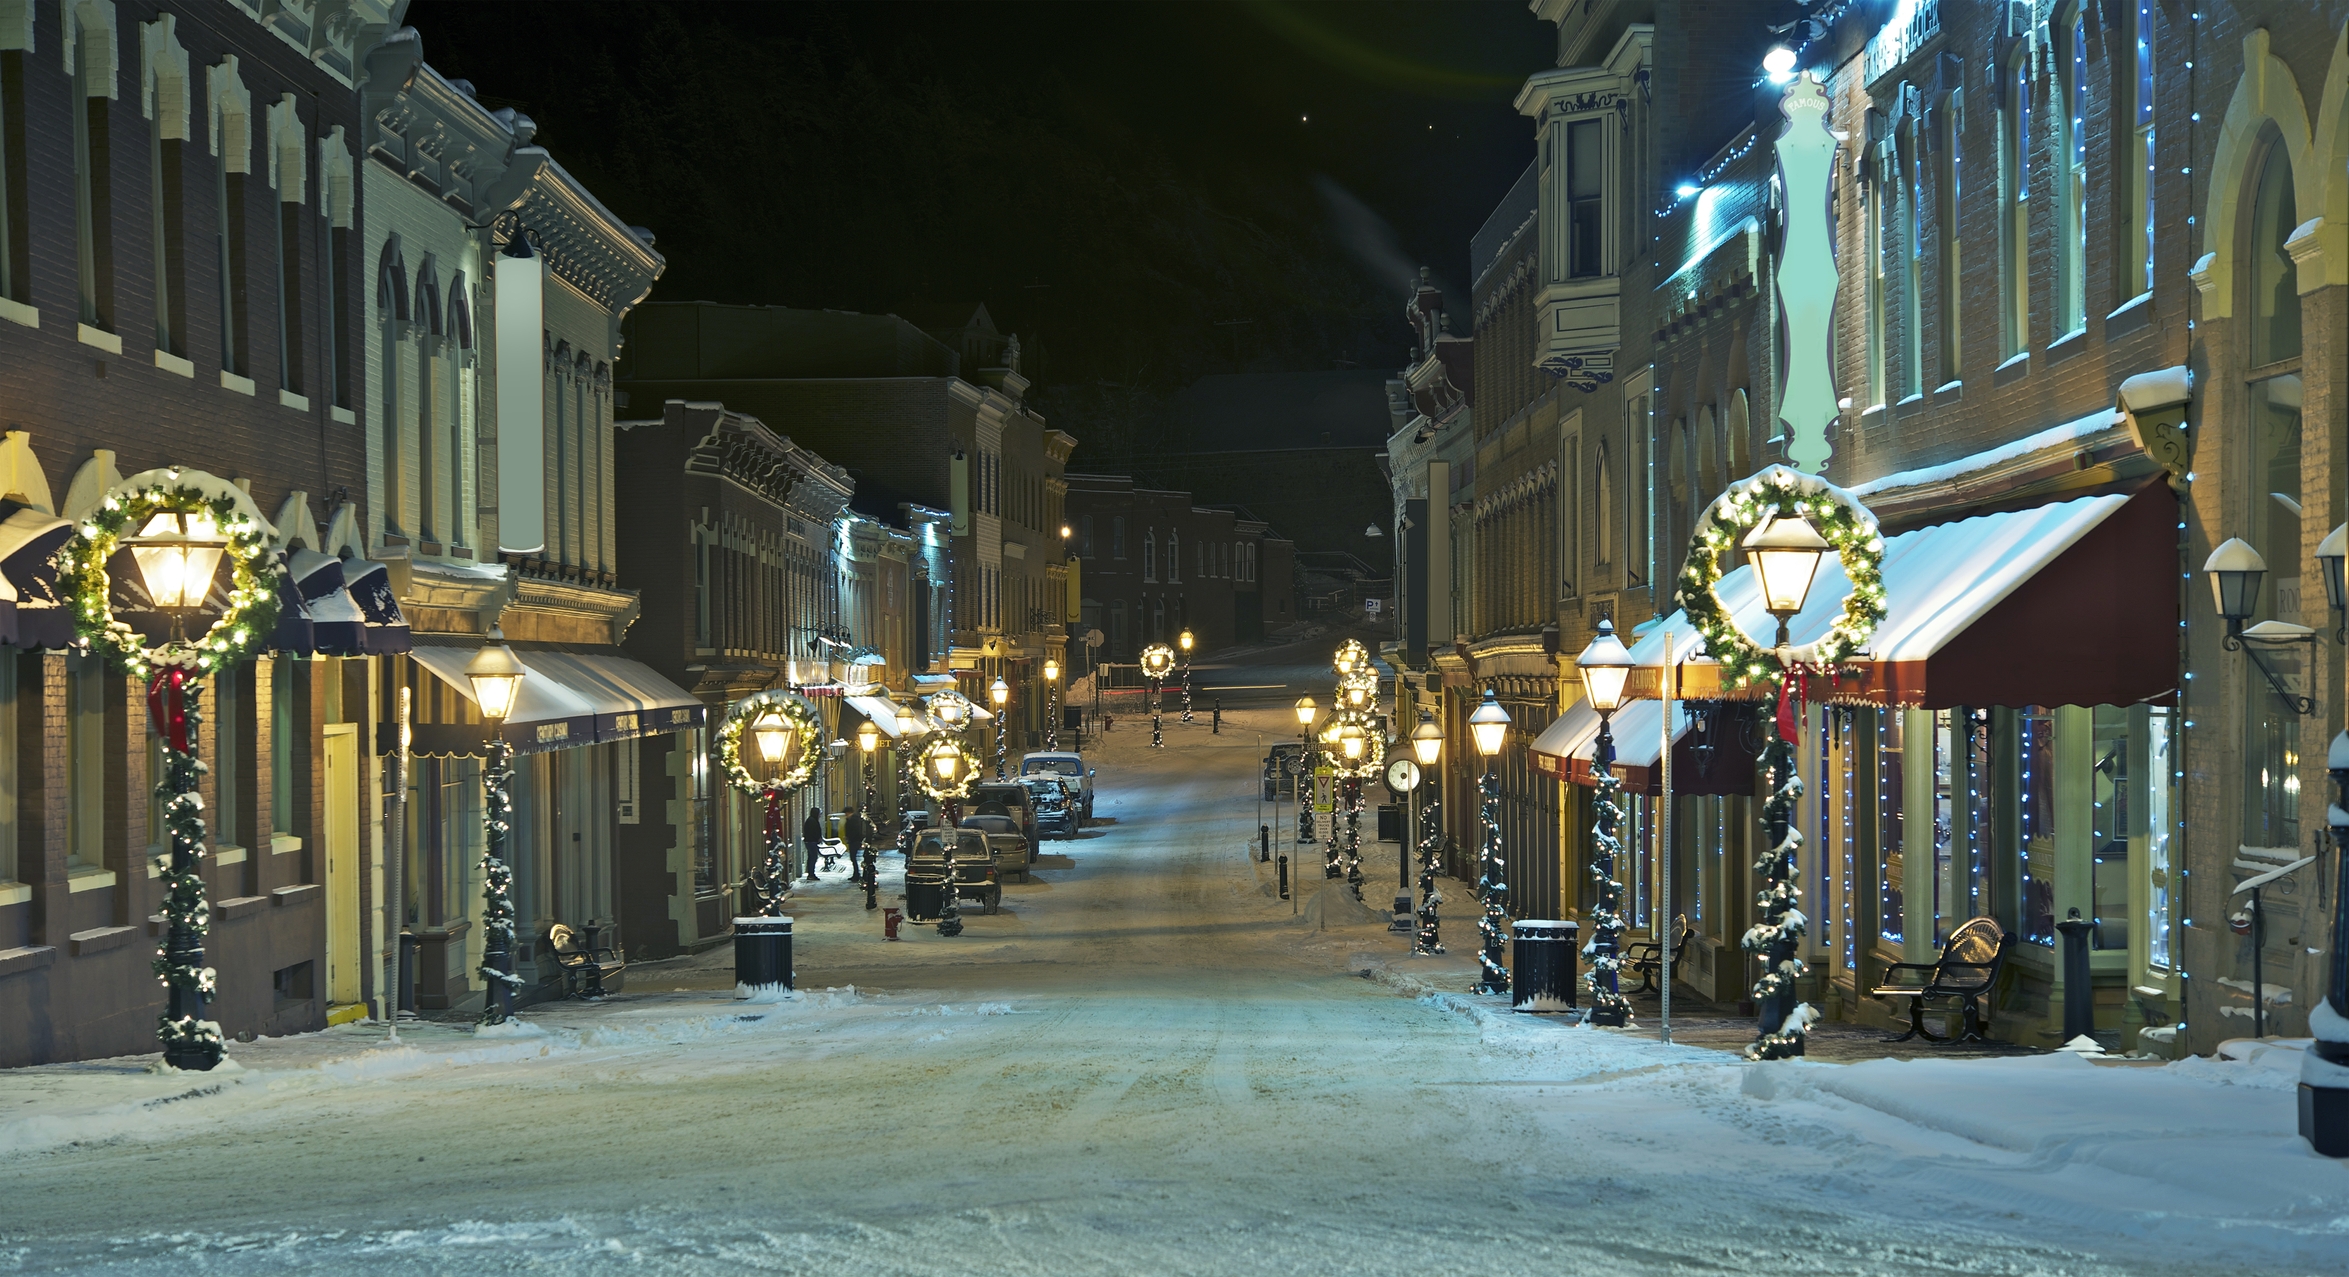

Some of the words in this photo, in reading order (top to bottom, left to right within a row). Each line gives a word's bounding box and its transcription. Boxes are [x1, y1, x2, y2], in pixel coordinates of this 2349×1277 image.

[1787, 98, 1826, 112] FAMOUS
[1366, 600, 1374, 610] P
[1631, 668, 1657, 690] FAMOUS
[855, 739, 892, 748] SET
